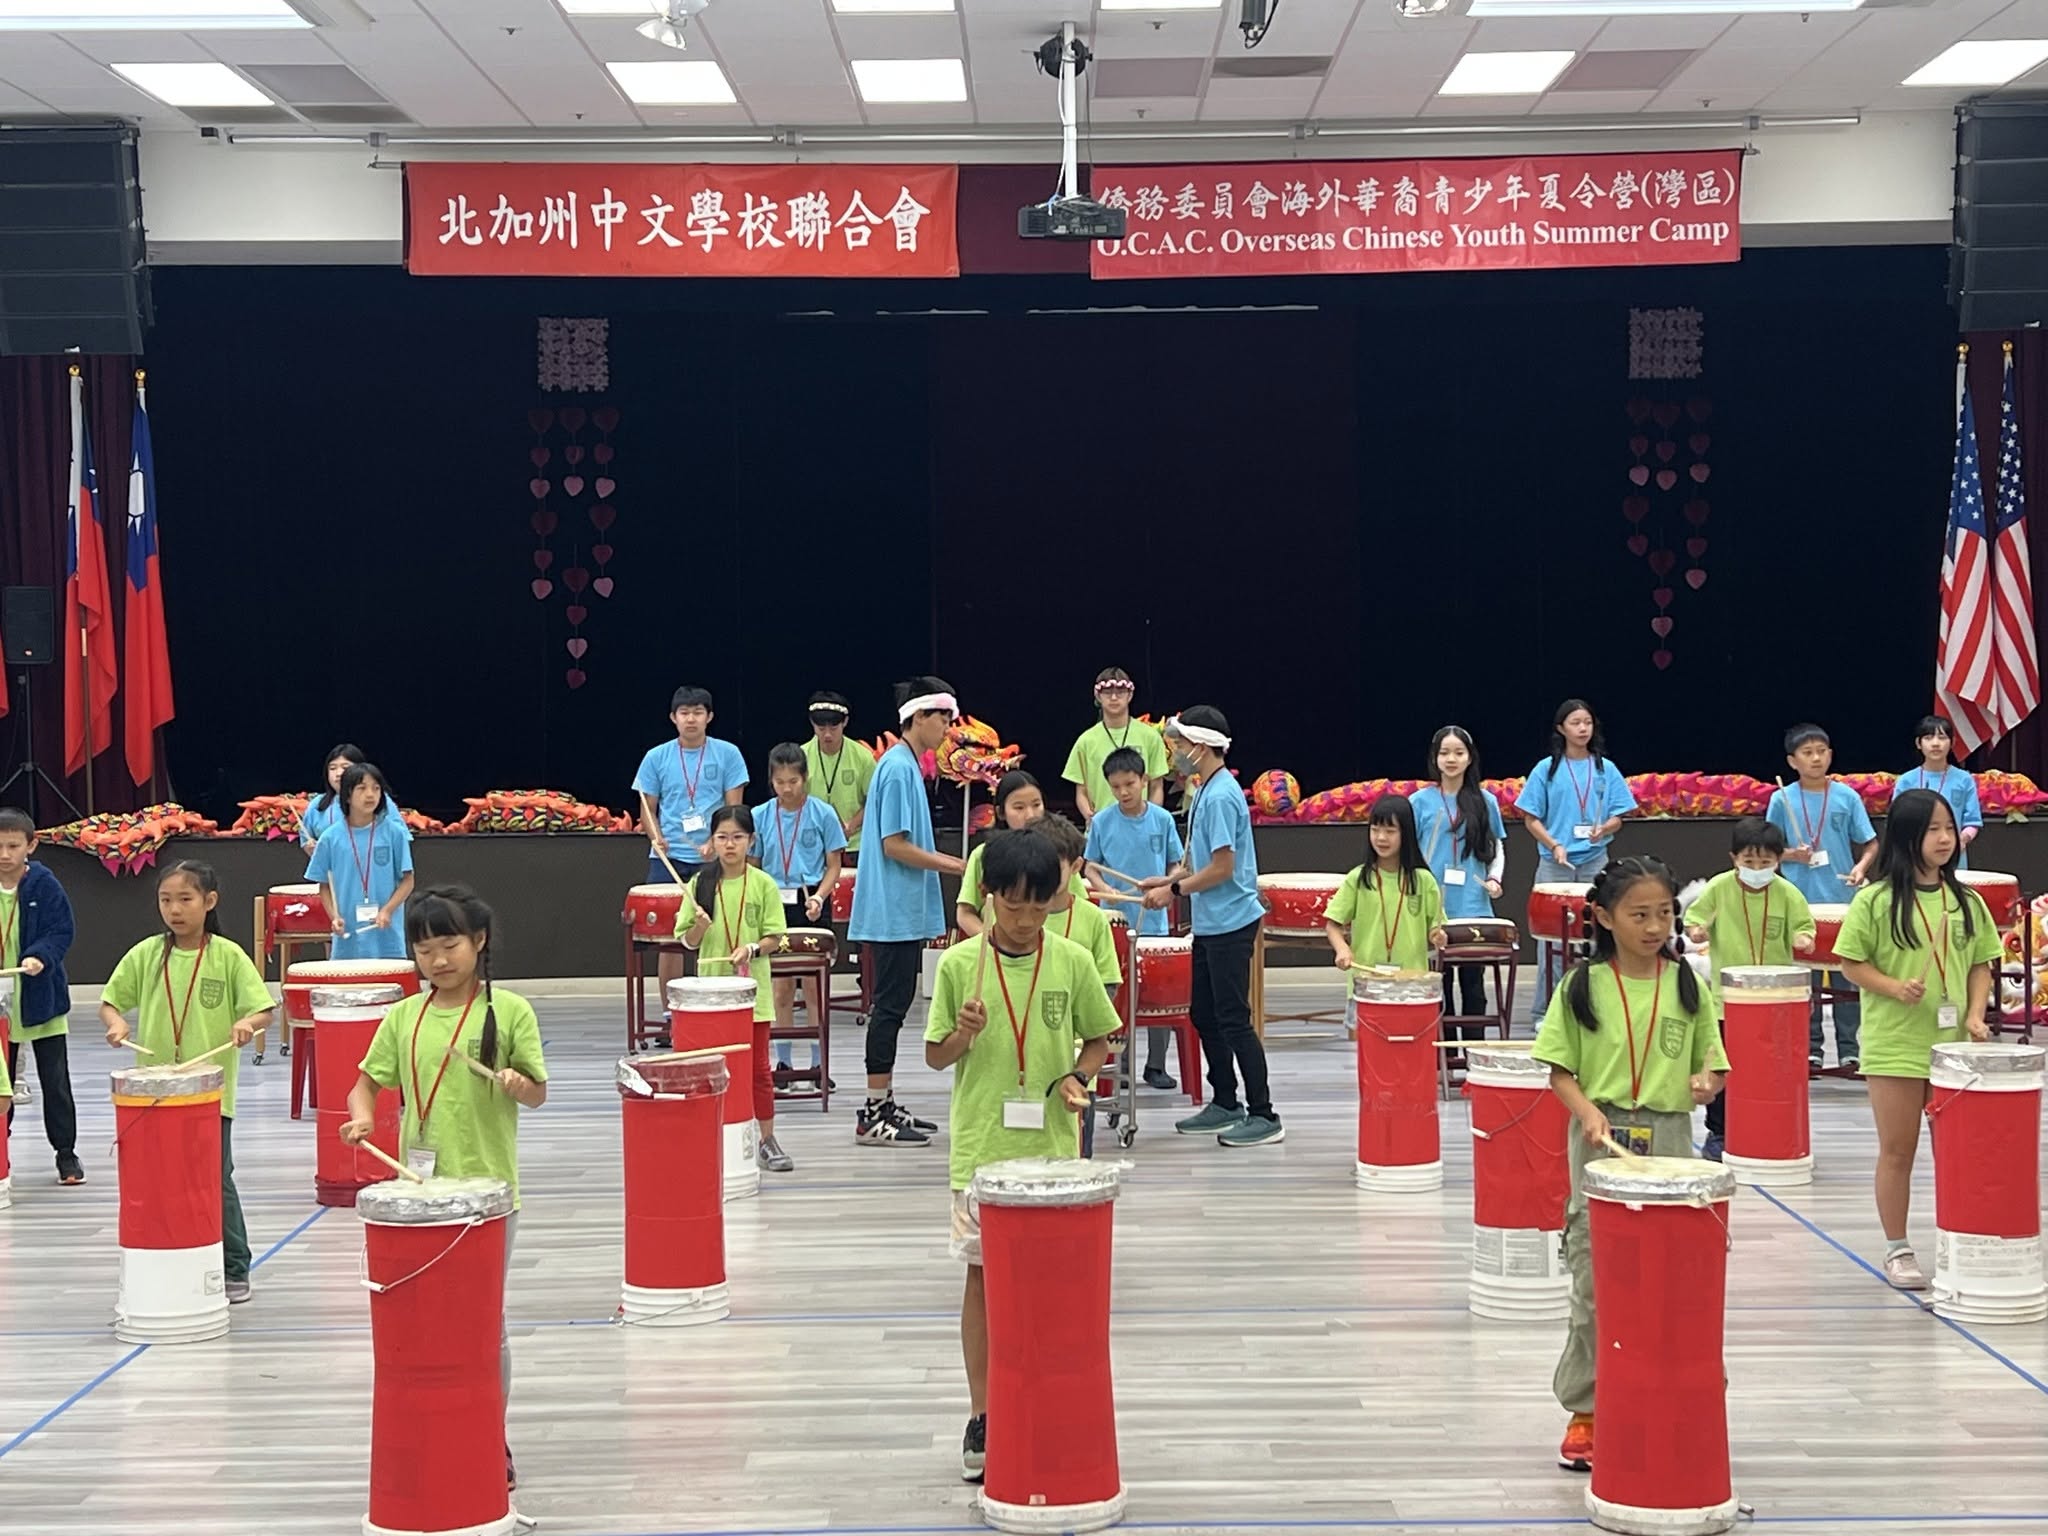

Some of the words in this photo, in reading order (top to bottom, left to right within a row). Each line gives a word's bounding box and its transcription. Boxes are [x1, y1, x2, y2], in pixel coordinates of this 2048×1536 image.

[438, 186, 931, 253] 北加州中文學校聯合會
[1220, 229, 1336, 253] Overseas
[1342, 225, 1444, 251] Chinese
[1449, 222, 1527, 248] Youth
[1533, 220, 1644, 245] Summer
[1649, 217, 1730, 246] Camp
